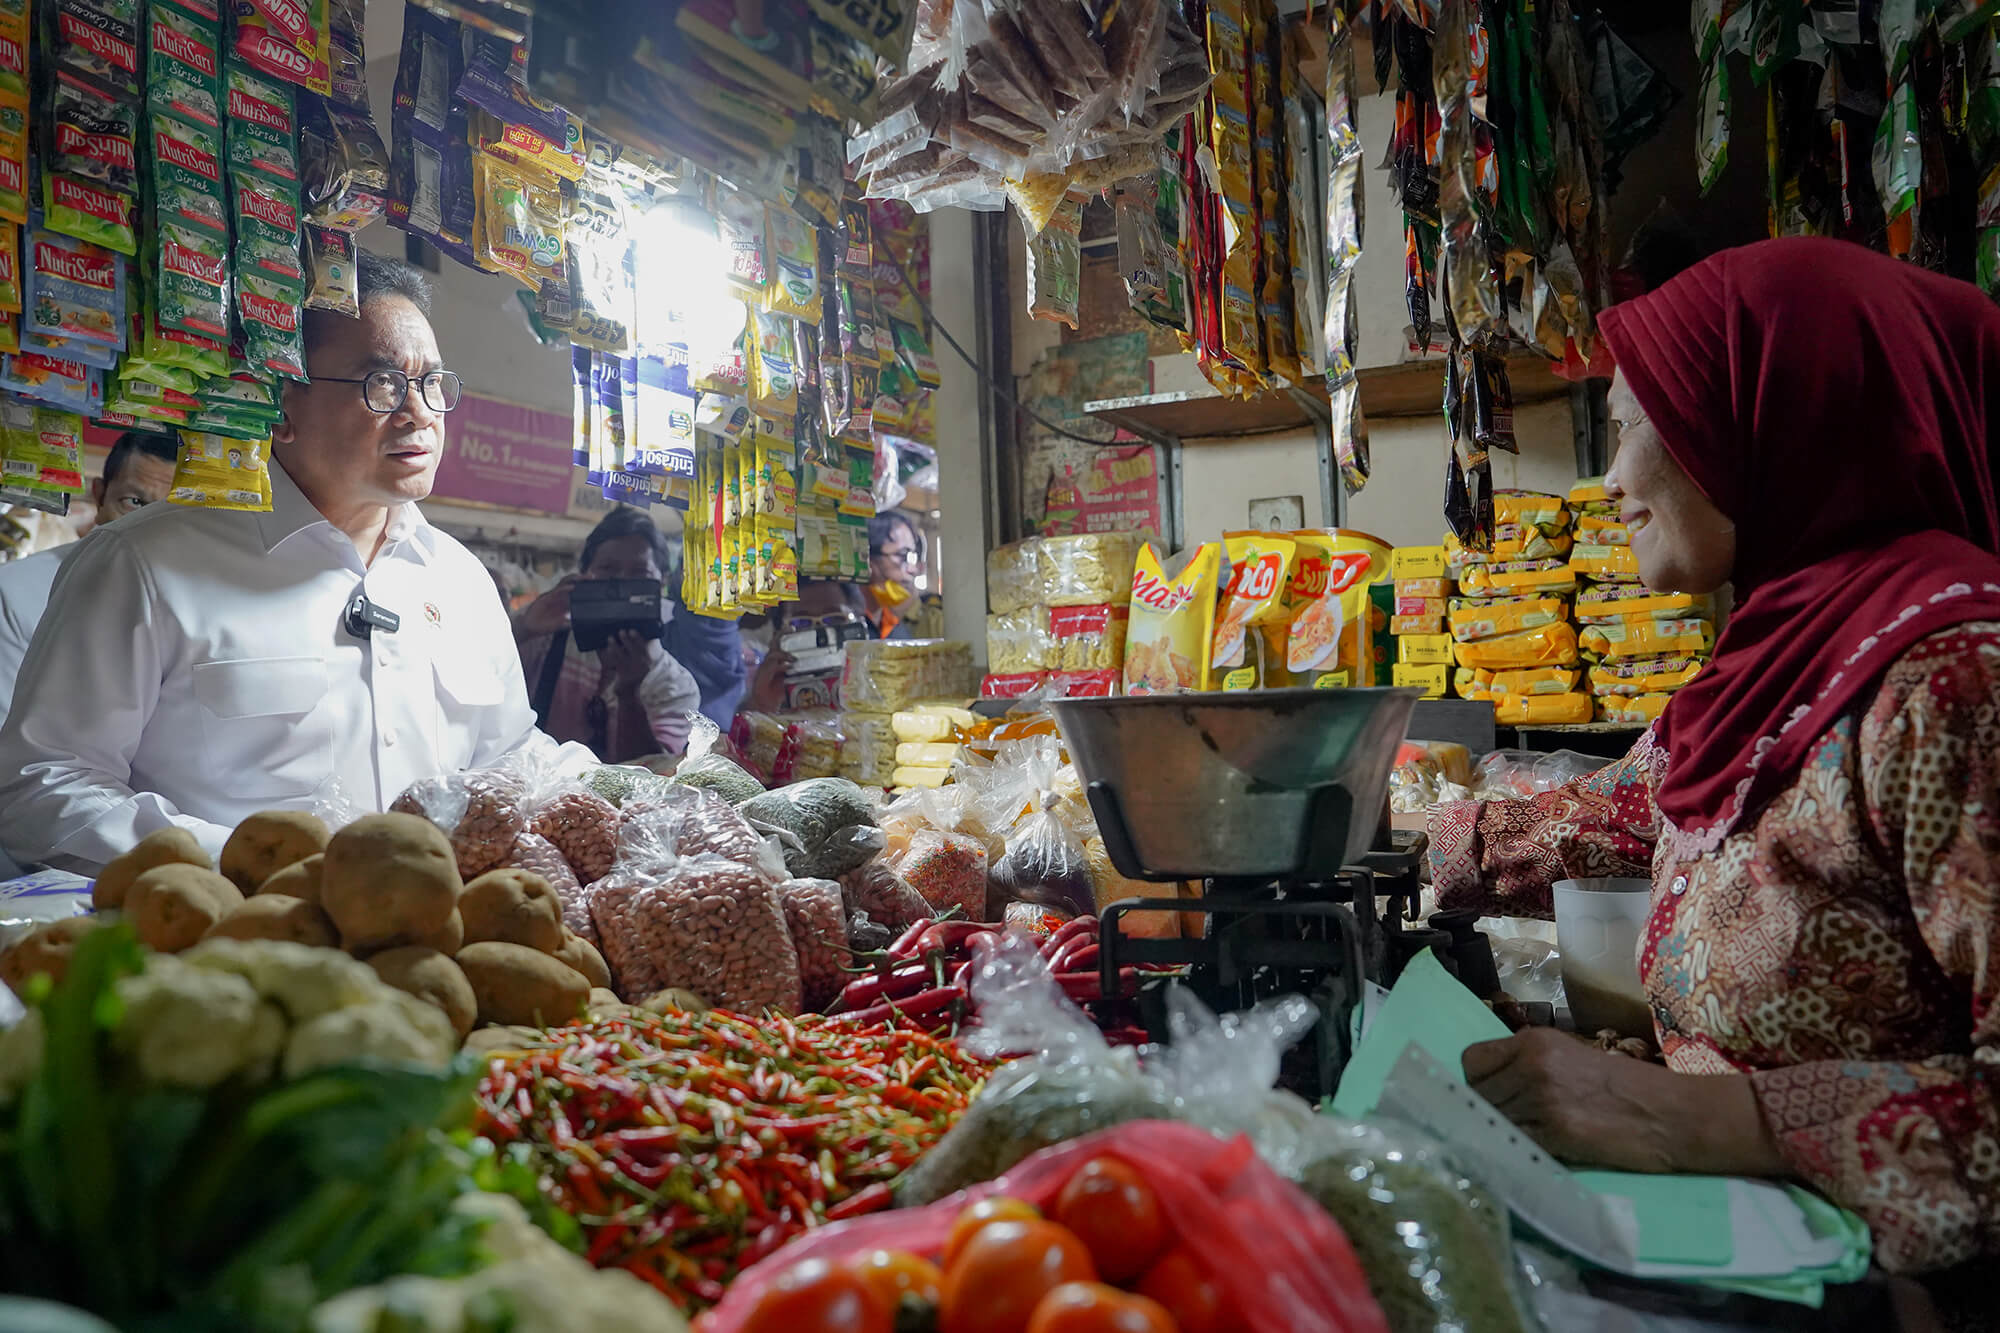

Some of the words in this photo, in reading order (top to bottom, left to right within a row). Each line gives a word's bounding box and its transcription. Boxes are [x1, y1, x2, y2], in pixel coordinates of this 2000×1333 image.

[68, 19, 134, 70] NutriSari
[157, 25, 213, 73] NutriSari
[264, 41, 308, 73] SUN
[169, 61, 204, 87] Sirsak
[231, 92, 288, 130] NutriSari
[246, 123, 281, 144] Sirsak
[160, 135, 216, 177] NutriSari
[175, 169, 210, 193] Sirsak
[243, 192, 294, 228] NutriSari
[40, 245, 111, 285] NutriSari
[168, 245, 222, 283] NutriSari
[243, 295, 293, 329] NutriSari
[641, 450, 695, 476] Entrasol
[607, 472, 651, 496] Entrasol
